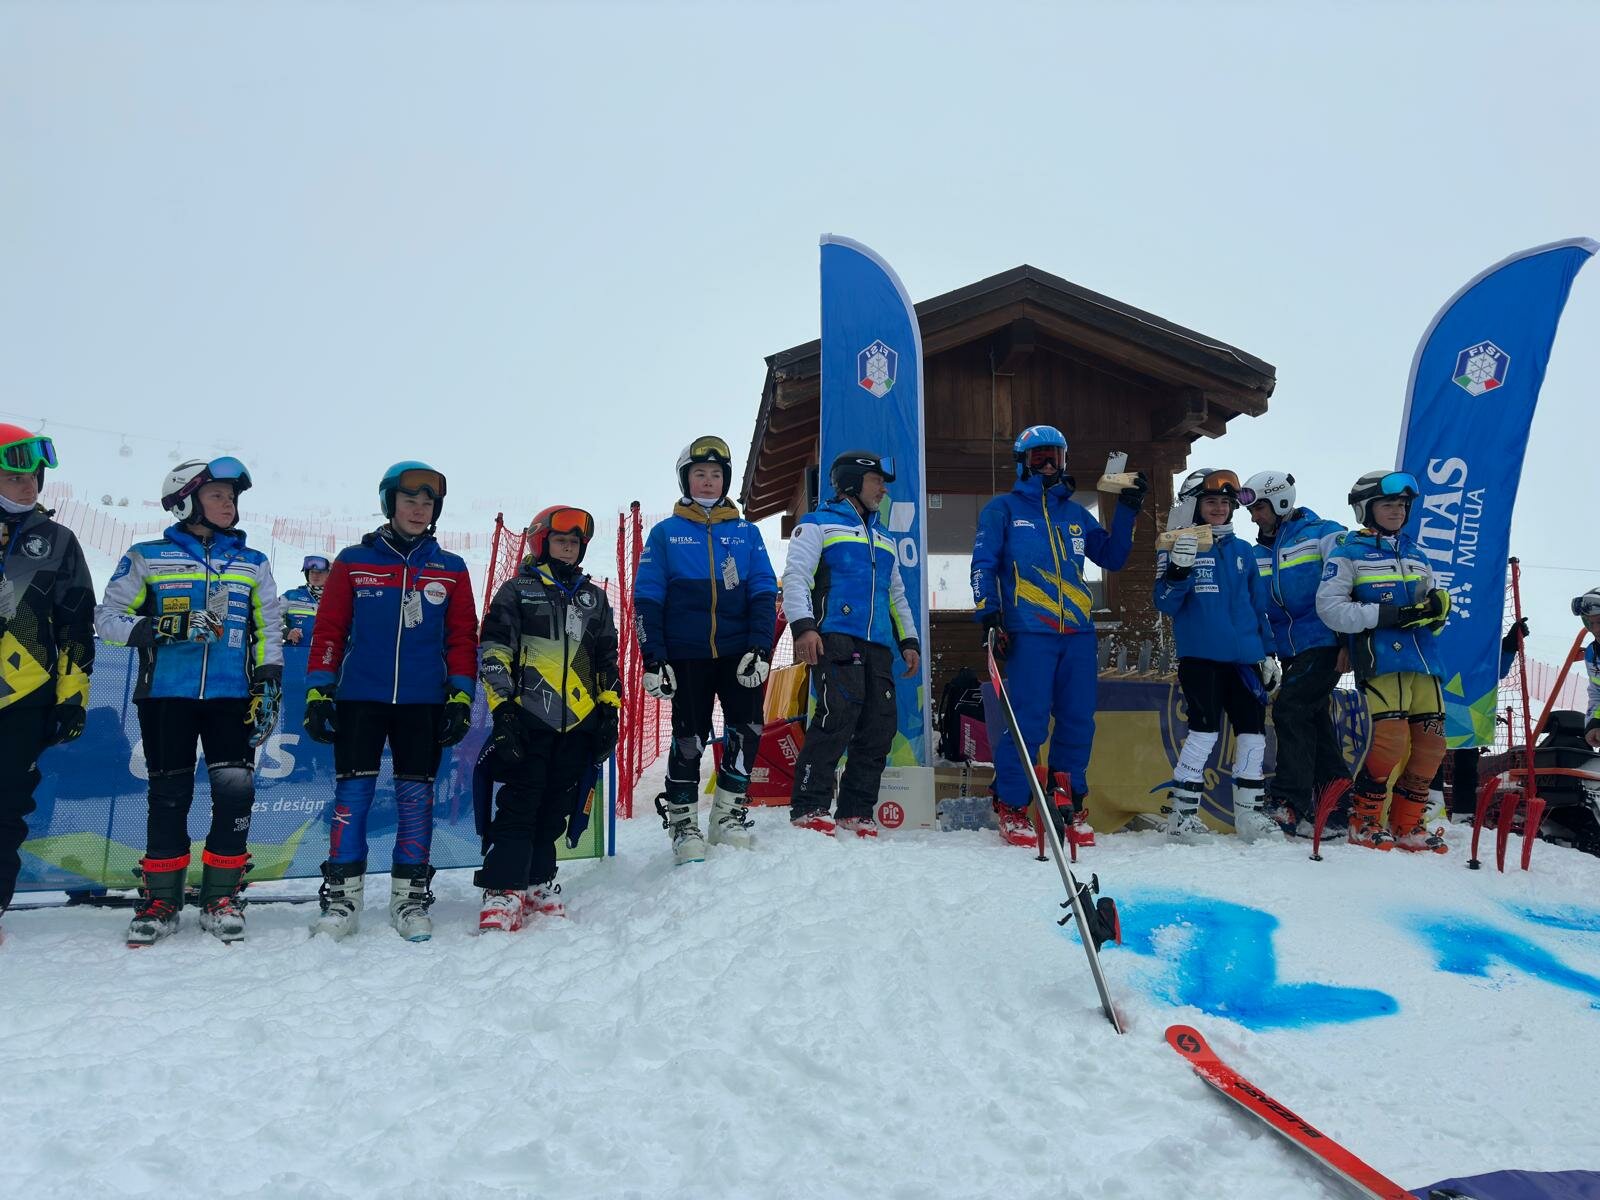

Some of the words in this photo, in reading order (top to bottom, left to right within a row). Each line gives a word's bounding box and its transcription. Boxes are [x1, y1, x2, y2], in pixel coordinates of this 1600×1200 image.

[1469, 346, 1501, 359] FISI
[1416, 457, 1468, 565] ITAS
[1457, 488, 1486, 568] MUTUA
[272, 797, 325, 815] design
